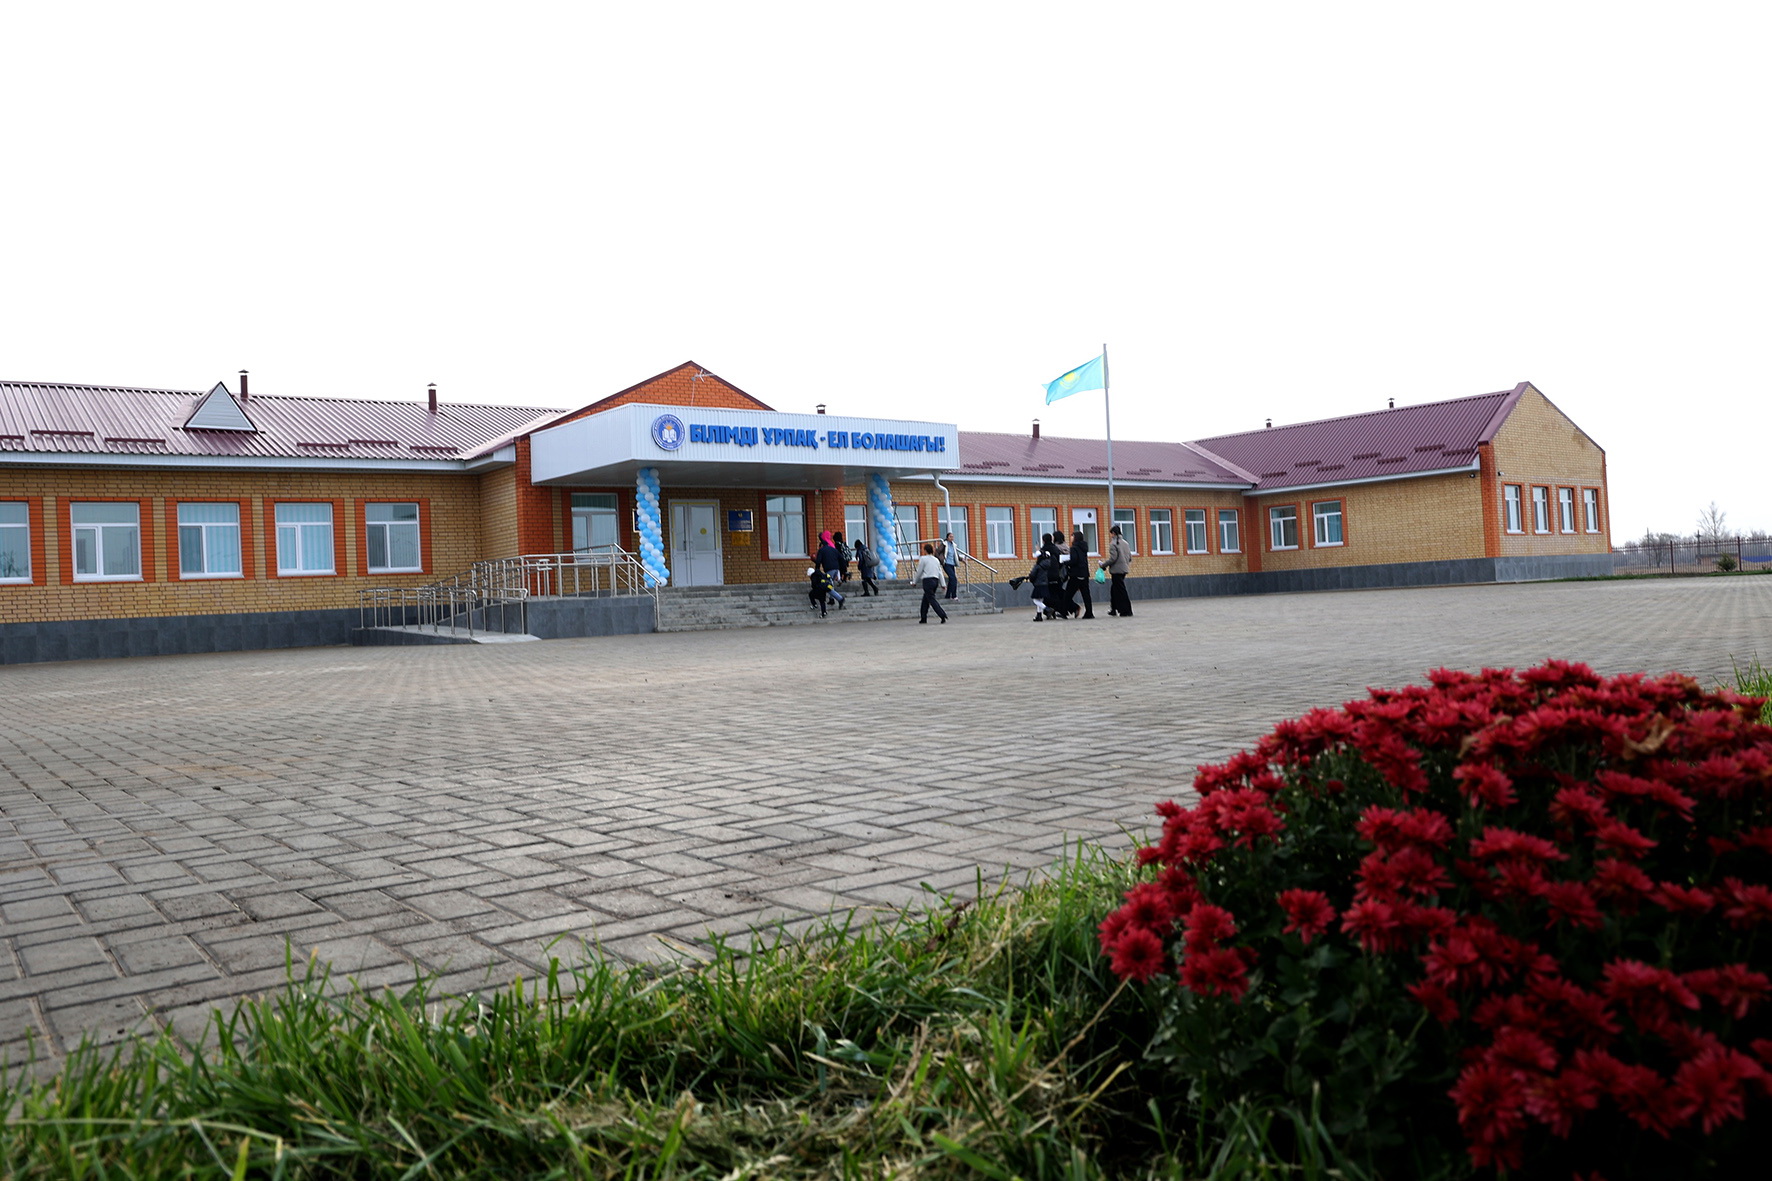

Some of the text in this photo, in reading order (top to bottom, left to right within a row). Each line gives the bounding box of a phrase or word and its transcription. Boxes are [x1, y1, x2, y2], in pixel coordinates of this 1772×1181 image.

[690, 424, 758, 447] БІЛІМДІ
[762, 427, 818, 449] ҰРПАҚ
[827, 430, 848, 448] ЕЛ
[851, 432, 945, 452] БОЛАШАҒЫ!
